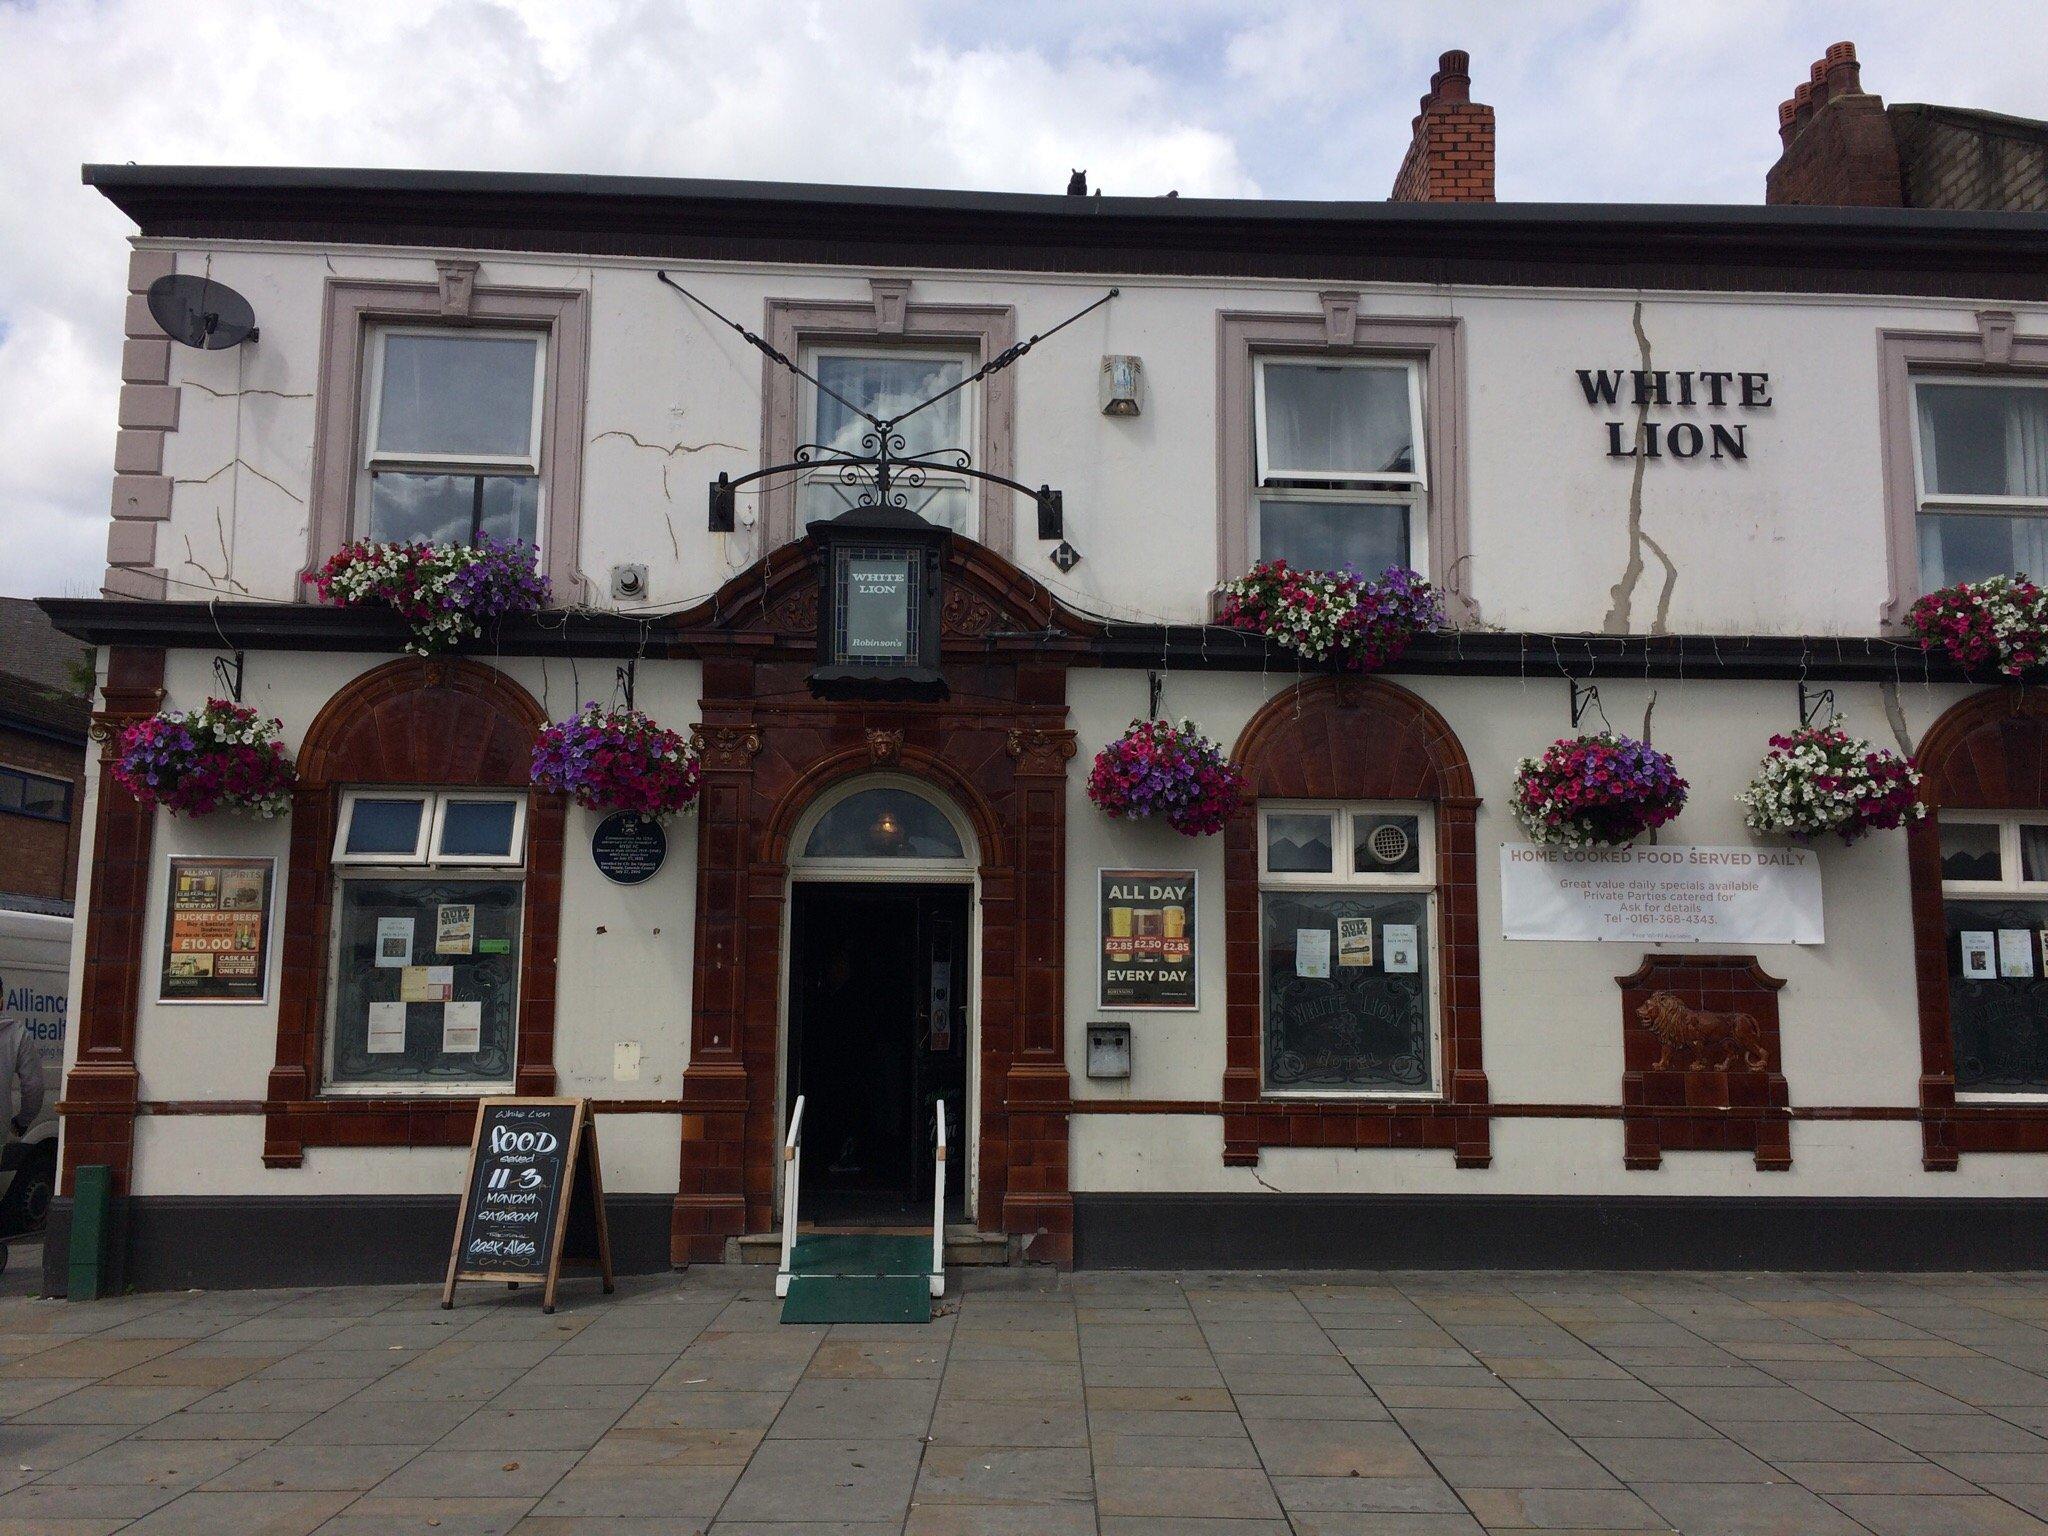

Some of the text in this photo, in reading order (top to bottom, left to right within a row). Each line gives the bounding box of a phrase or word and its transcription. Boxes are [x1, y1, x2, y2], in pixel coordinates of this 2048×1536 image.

[1575, 369, 1773, 407] WHITE
[1605, 422, 1748, 459] LION
[1056, 547, 1073, 565] H
[852, 573, 905, 582] WHITE
[859, 585, 897, 594] LION
[852, 638, 903, 647] Robinson's
[1511, 850, 1806, 866] HOME COOKED FOOD SERVED DAILY
[1560, 879, 1760, 891] Great value daily specials available
[1108, 885, 1188, 901] ALL DAY
[1584, 891, 1624, 901] Private
[1628, 891, 1667, 901] Parties
[1670, 892, 1714, 901] catered
[1620, 903, 1702, 912] Ask for details
[175, 913, 259, 922] BUCKET OF BEER
[1604, 914, 1622, 923] Tel
[1341, 921, 1368, 932] QUIZ
[181, 938, 232, 950] £10.00
[1105, 942, 1133, 951] £2.85
[1134, 940, 1162, 949] £2.50
[1163, 943, 1190, 951] £2.85
[1107, 970, 1187, 982] EVERY DAY
[495, 1109, 525, 1119] White
[486, 1193, 537, 1204] MONDAY
[478, 1210, 539, 1224] SATURDAY
[469, 1238, 536, 1256] Cask Ales
